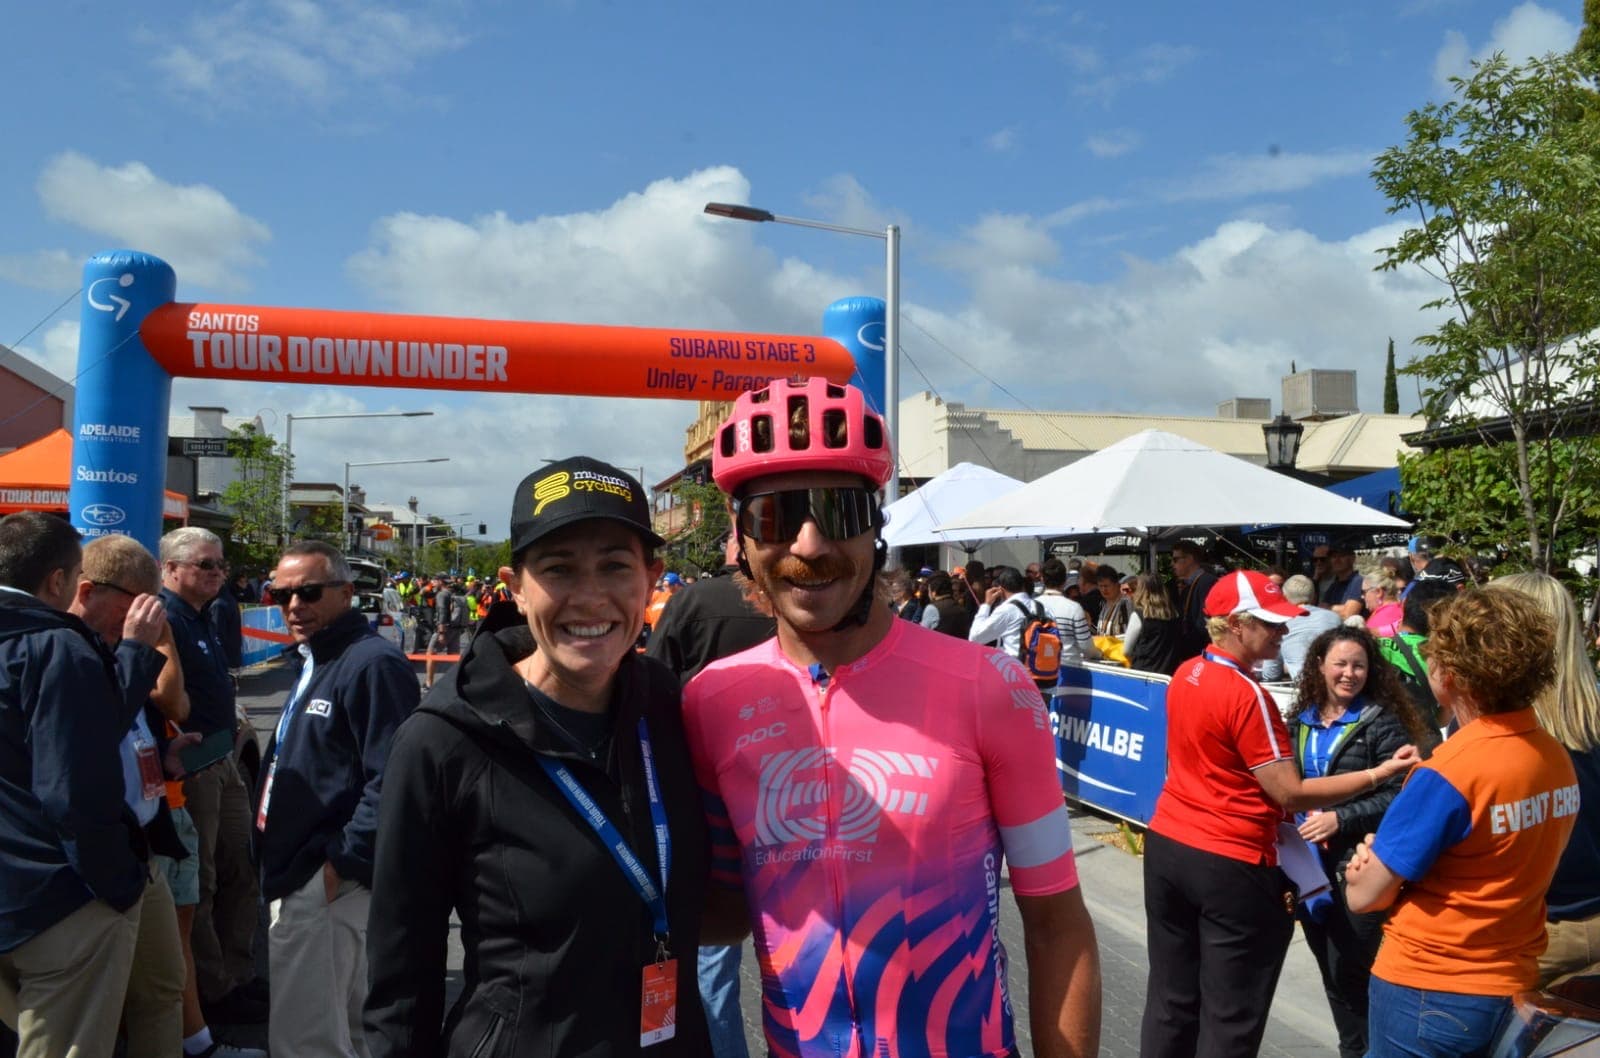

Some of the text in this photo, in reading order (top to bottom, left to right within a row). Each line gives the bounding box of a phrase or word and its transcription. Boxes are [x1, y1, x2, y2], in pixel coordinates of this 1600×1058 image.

[188, 311, 259, 331] SANTOS
[187, 331, 508, 382] TOUR DOWN UNDER
[670, 337, 816, 363] SUBARU STAGE 3
[646, 367, 698, 392] Unley
[80, 424, 140, 438] ADELAIDE
[77, 464, 138, 485] Santos
[0, 489, 70, 504] TOUR DOWN
[309, 700, 330, 714] UCI
[555, 767, 580, 793] UNDER
[572, 786, 595, 811] DOWN
[587, 805, 609, 827] TOUR
[1490, 791, 1550, 834] EVENT
[754, 845, 873, 866] EducationFirst
